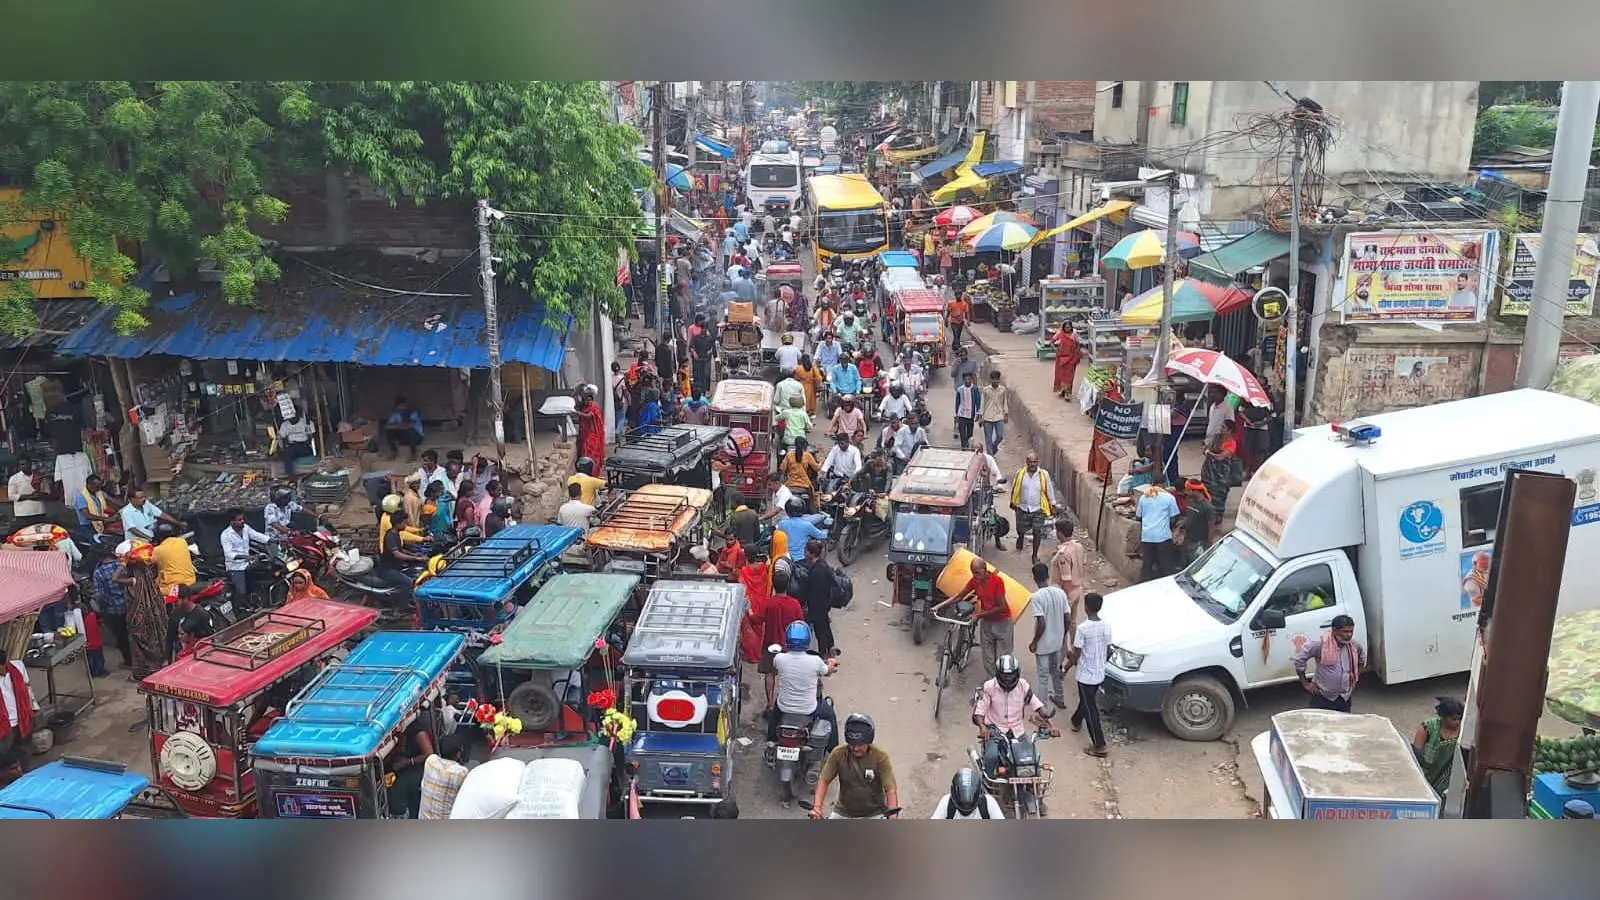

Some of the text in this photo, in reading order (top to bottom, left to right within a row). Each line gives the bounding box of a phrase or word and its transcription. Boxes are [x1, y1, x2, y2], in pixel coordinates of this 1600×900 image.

[1100, 409, 1142, 423] VENDING
[1114, 405, 1132, 415] NO
[1102, 420, 1133, 432] ZONE
